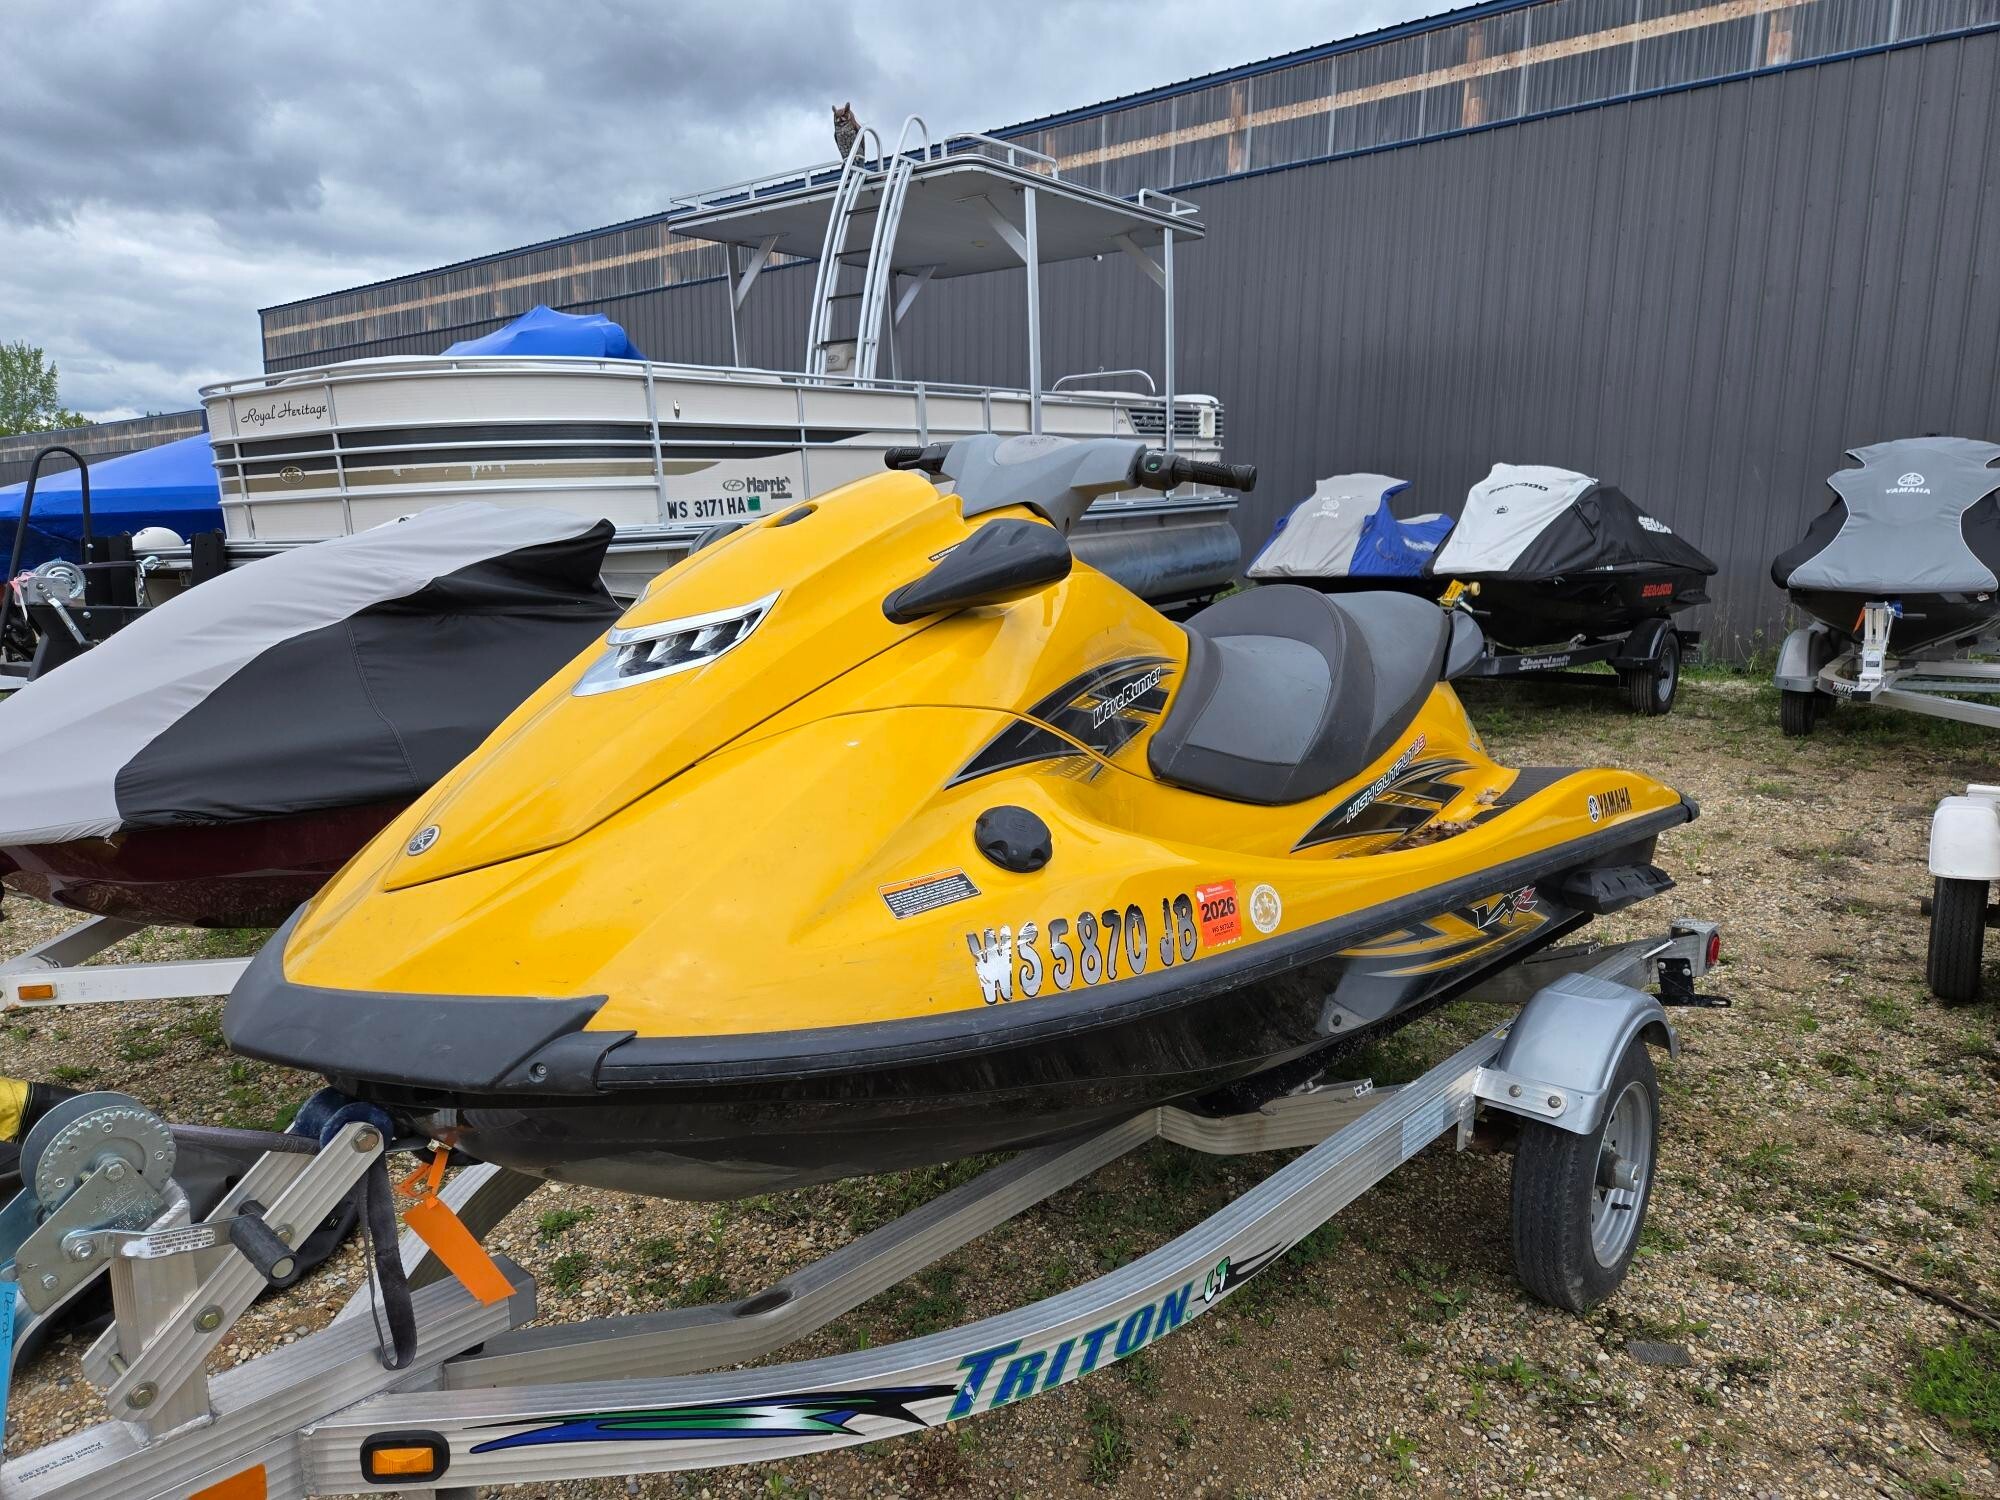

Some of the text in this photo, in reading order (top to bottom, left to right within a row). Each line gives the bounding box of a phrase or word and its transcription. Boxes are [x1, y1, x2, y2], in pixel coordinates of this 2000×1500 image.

[241, 400, 327, 426] Royal Heritage
[746, 477, 787, 493] Harris
[1886, 487, 1931, 495] YAMAHA
[667, 496, 746, 519] WS 3171 HA
[1093, 666, 1161, 730] WaveRunner
[1346, 784, 1375, 824] HIGH
[1374, 744, 1416, 797] OUTPUT
[1597, 787, 1632, 819] YAMAHA
[1201, 896, 1236, 922] 2026
[1472, 885, 1538, 930] VXR
[966, 921, 1043, 1005] WS
[1048, 903, 1148, 990] 5870
[1160, 893, 1198, 967] JB
[946, 1256, 1231, 1421] TRITON LT
